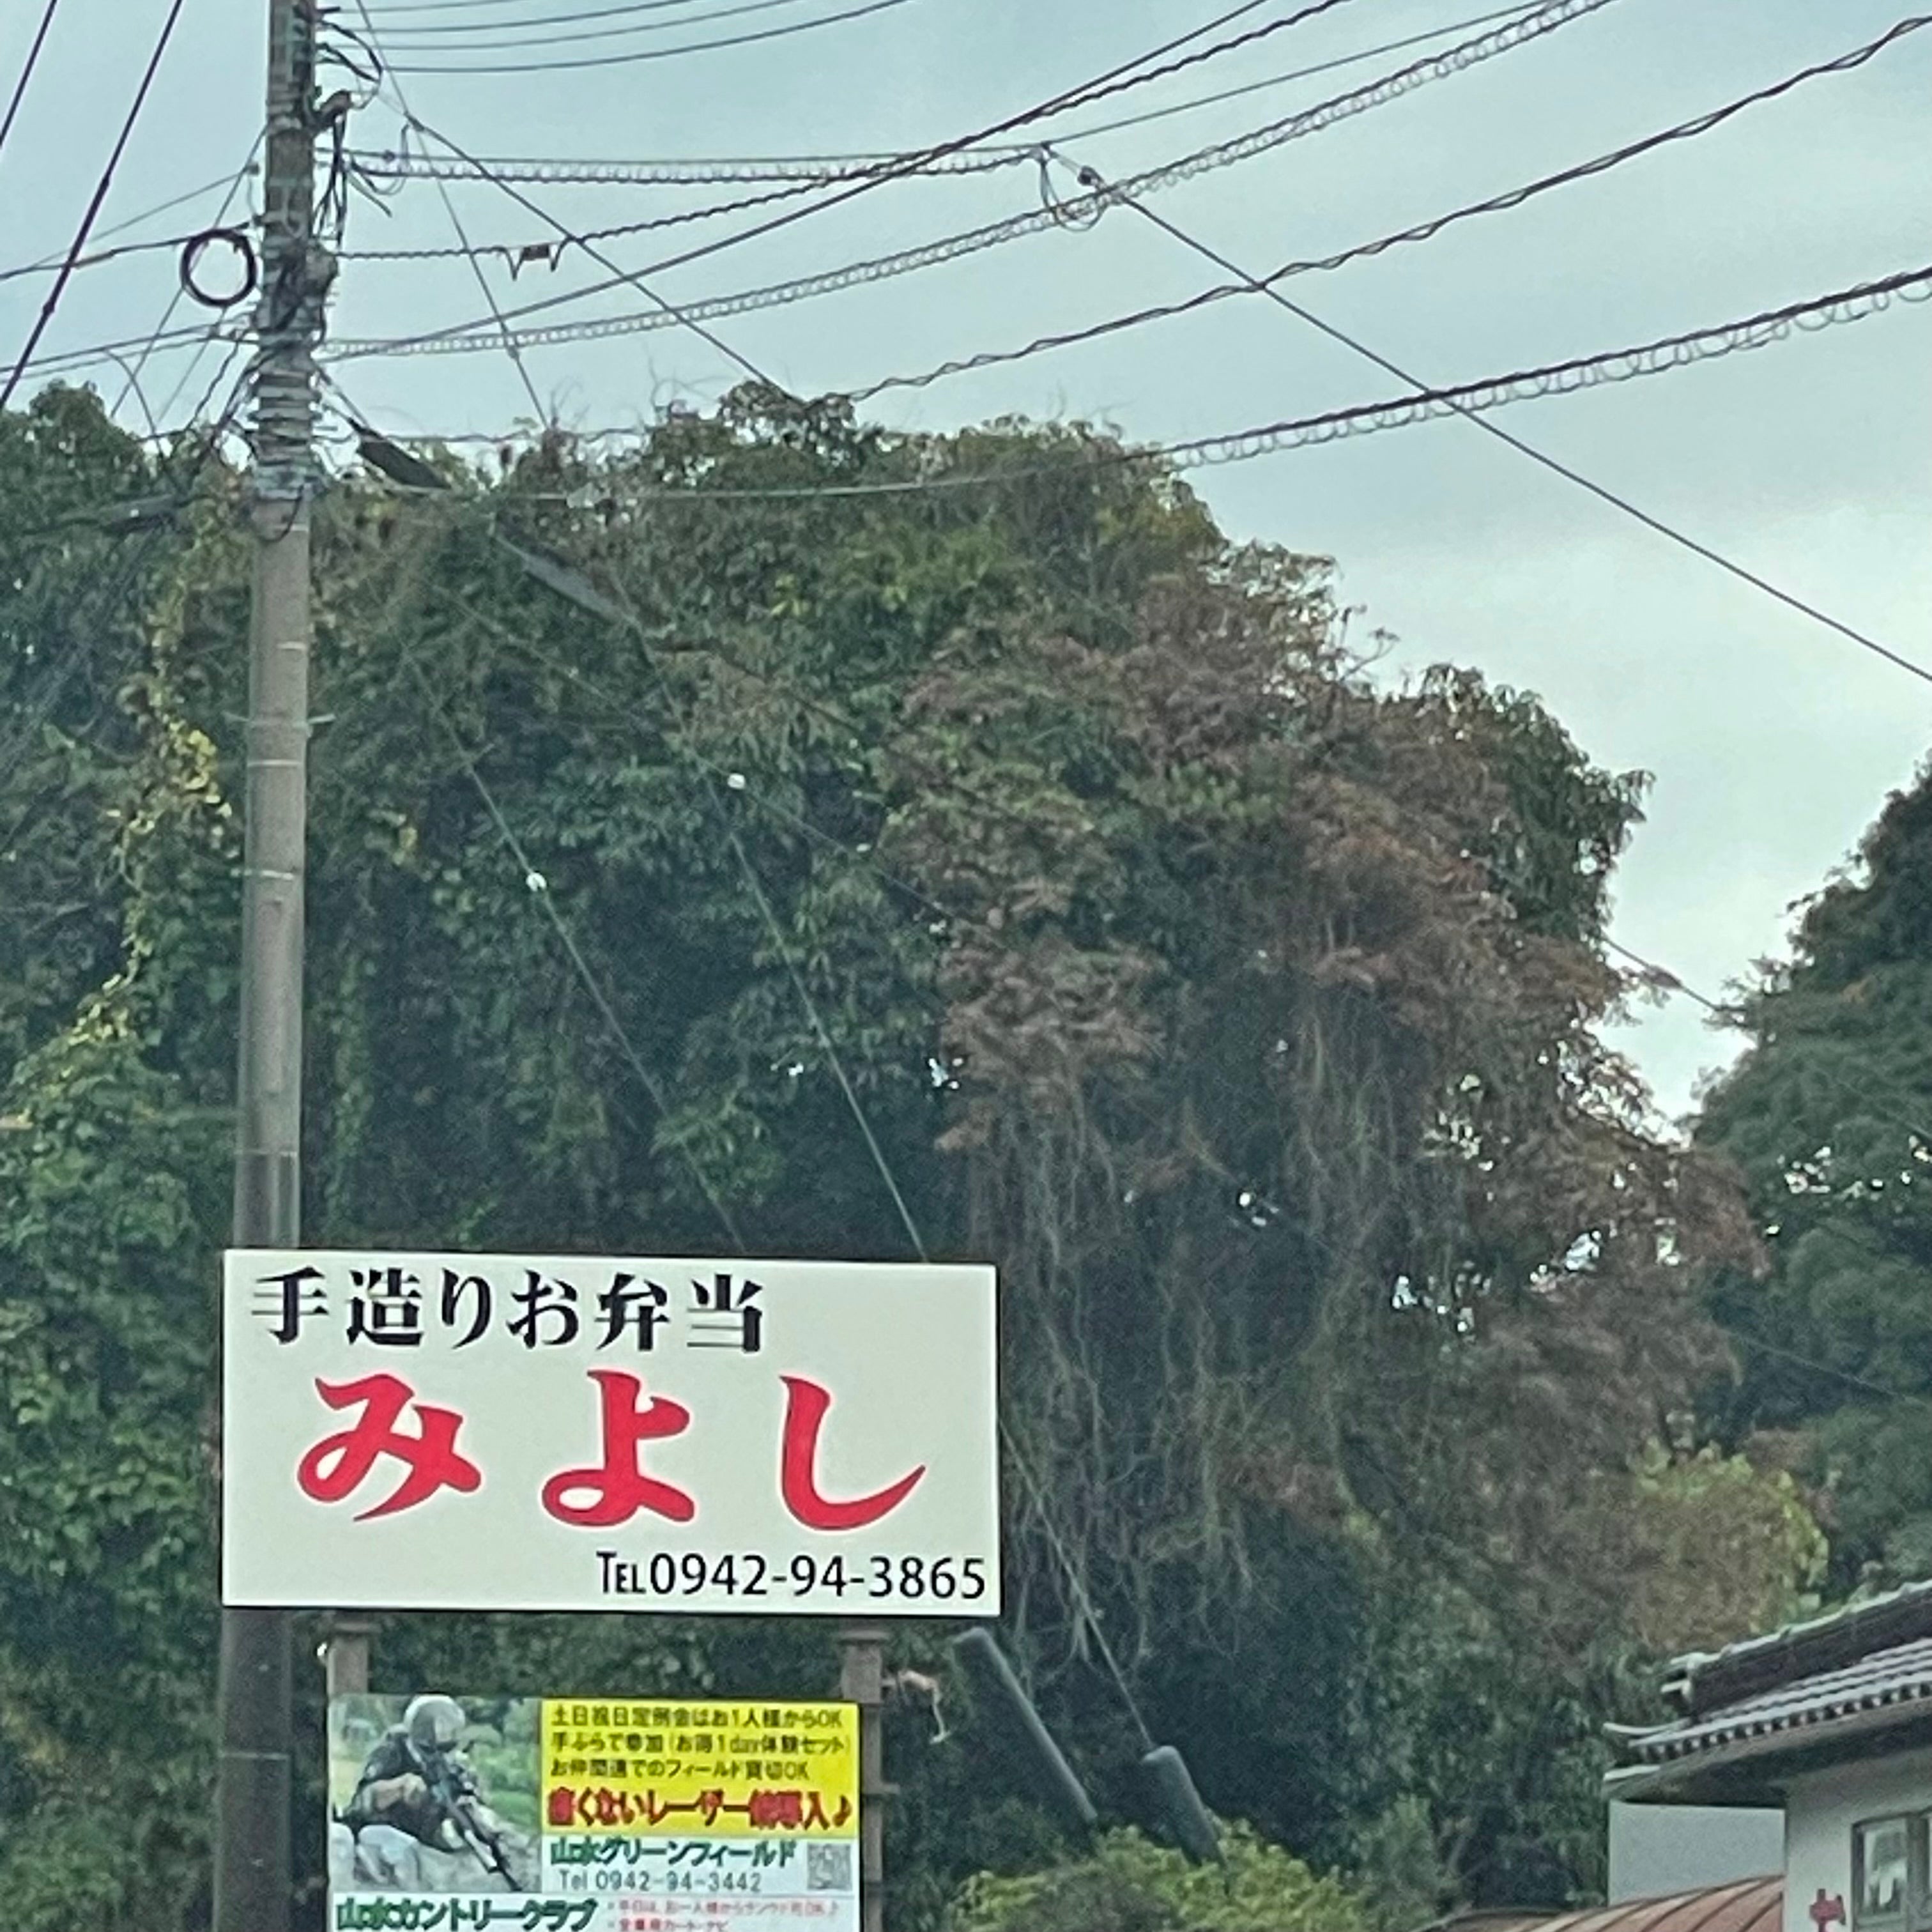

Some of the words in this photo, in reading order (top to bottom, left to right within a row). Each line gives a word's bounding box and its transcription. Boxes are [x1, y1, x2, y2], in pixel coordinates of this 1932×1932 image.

[252, 1266, 763, 1353] 手造りお弁当
[297, 1368, 926, 1531] みよし
[550, 1837, 797, 1867] 山水グリーンフィールド
[560, 1871, 588, 1890] Tel
[595, 1870, 762, 1892] 0942-94-3442
[335, 1897, 598, 1931] 山水カントリークラブ
